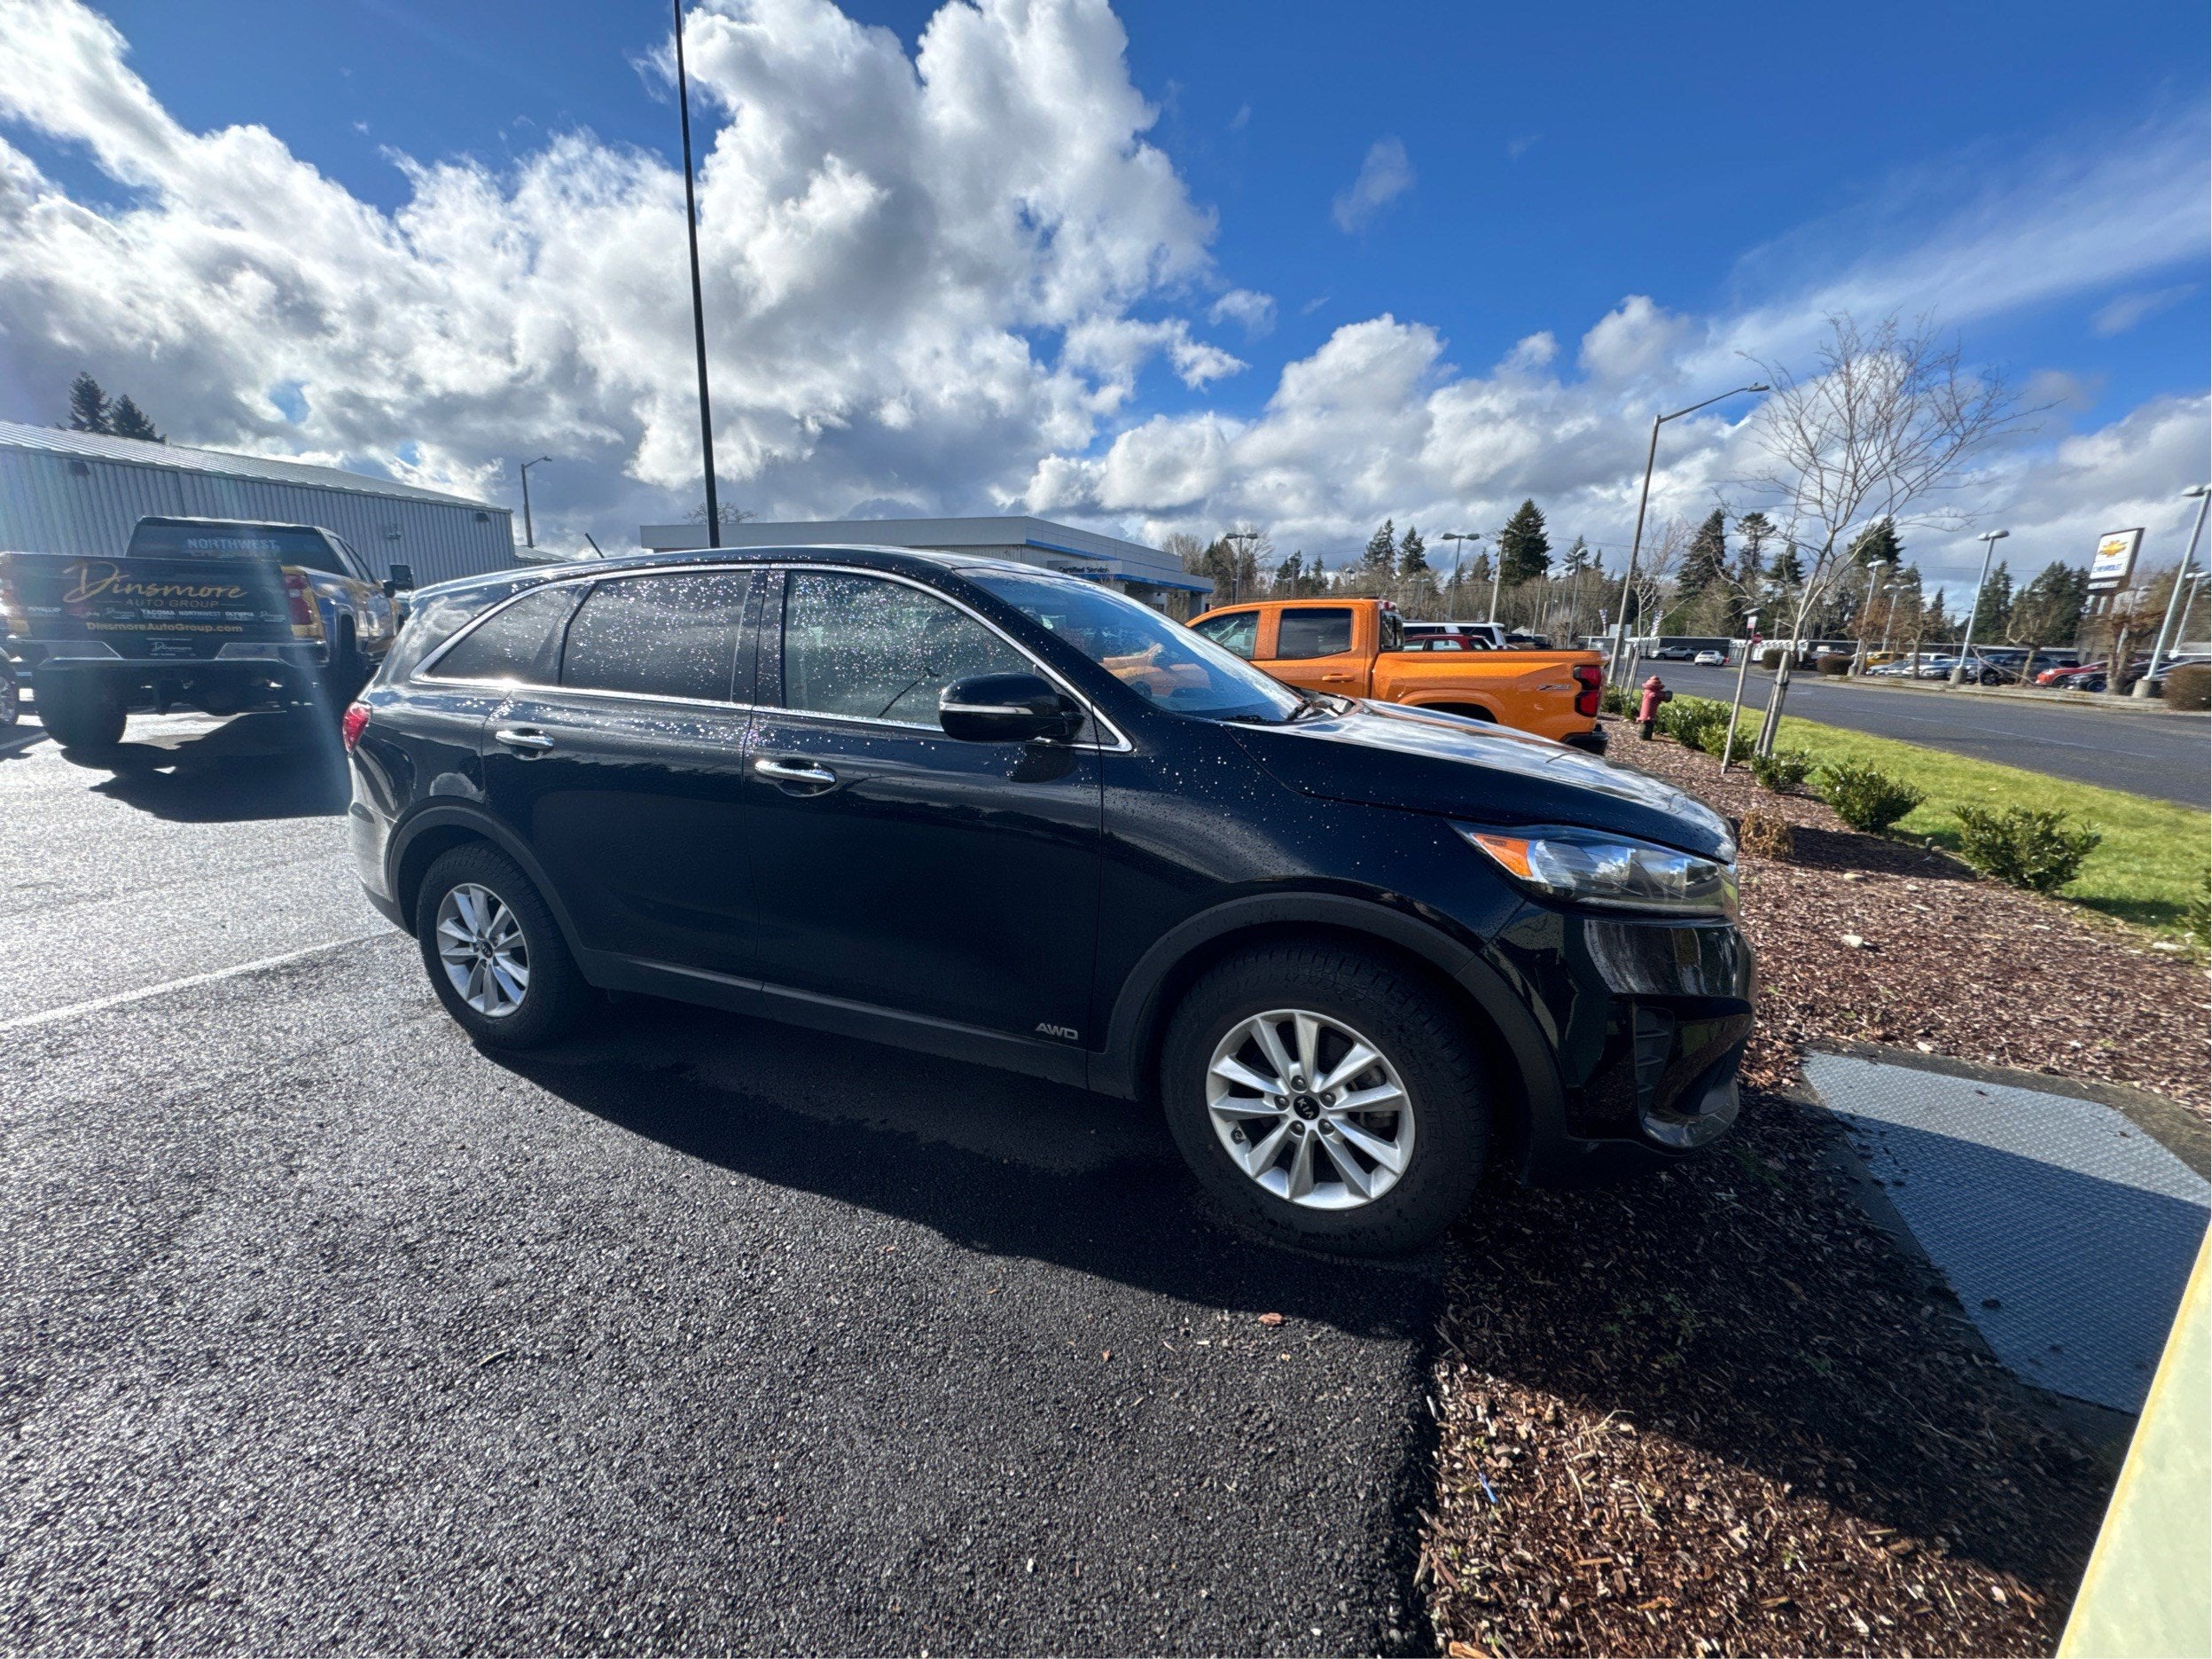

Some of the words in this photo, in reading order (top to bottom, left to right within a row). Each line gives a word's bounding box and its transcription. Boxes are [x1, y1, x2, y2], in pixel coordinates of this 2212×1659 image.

[187, 538, 277, 550] NORTHWEST
[62, 561, 248, 603] Dinsmore
[124, 599, 164, 608] AUTO
[169, 599, 220, 609] GROUP
[86, 622, 244, 633] DinsmoreAutoGroup.com
[1036, 1022, 1079, 1040] AWD
[1297, 1098, 1314, 1118] KIA
